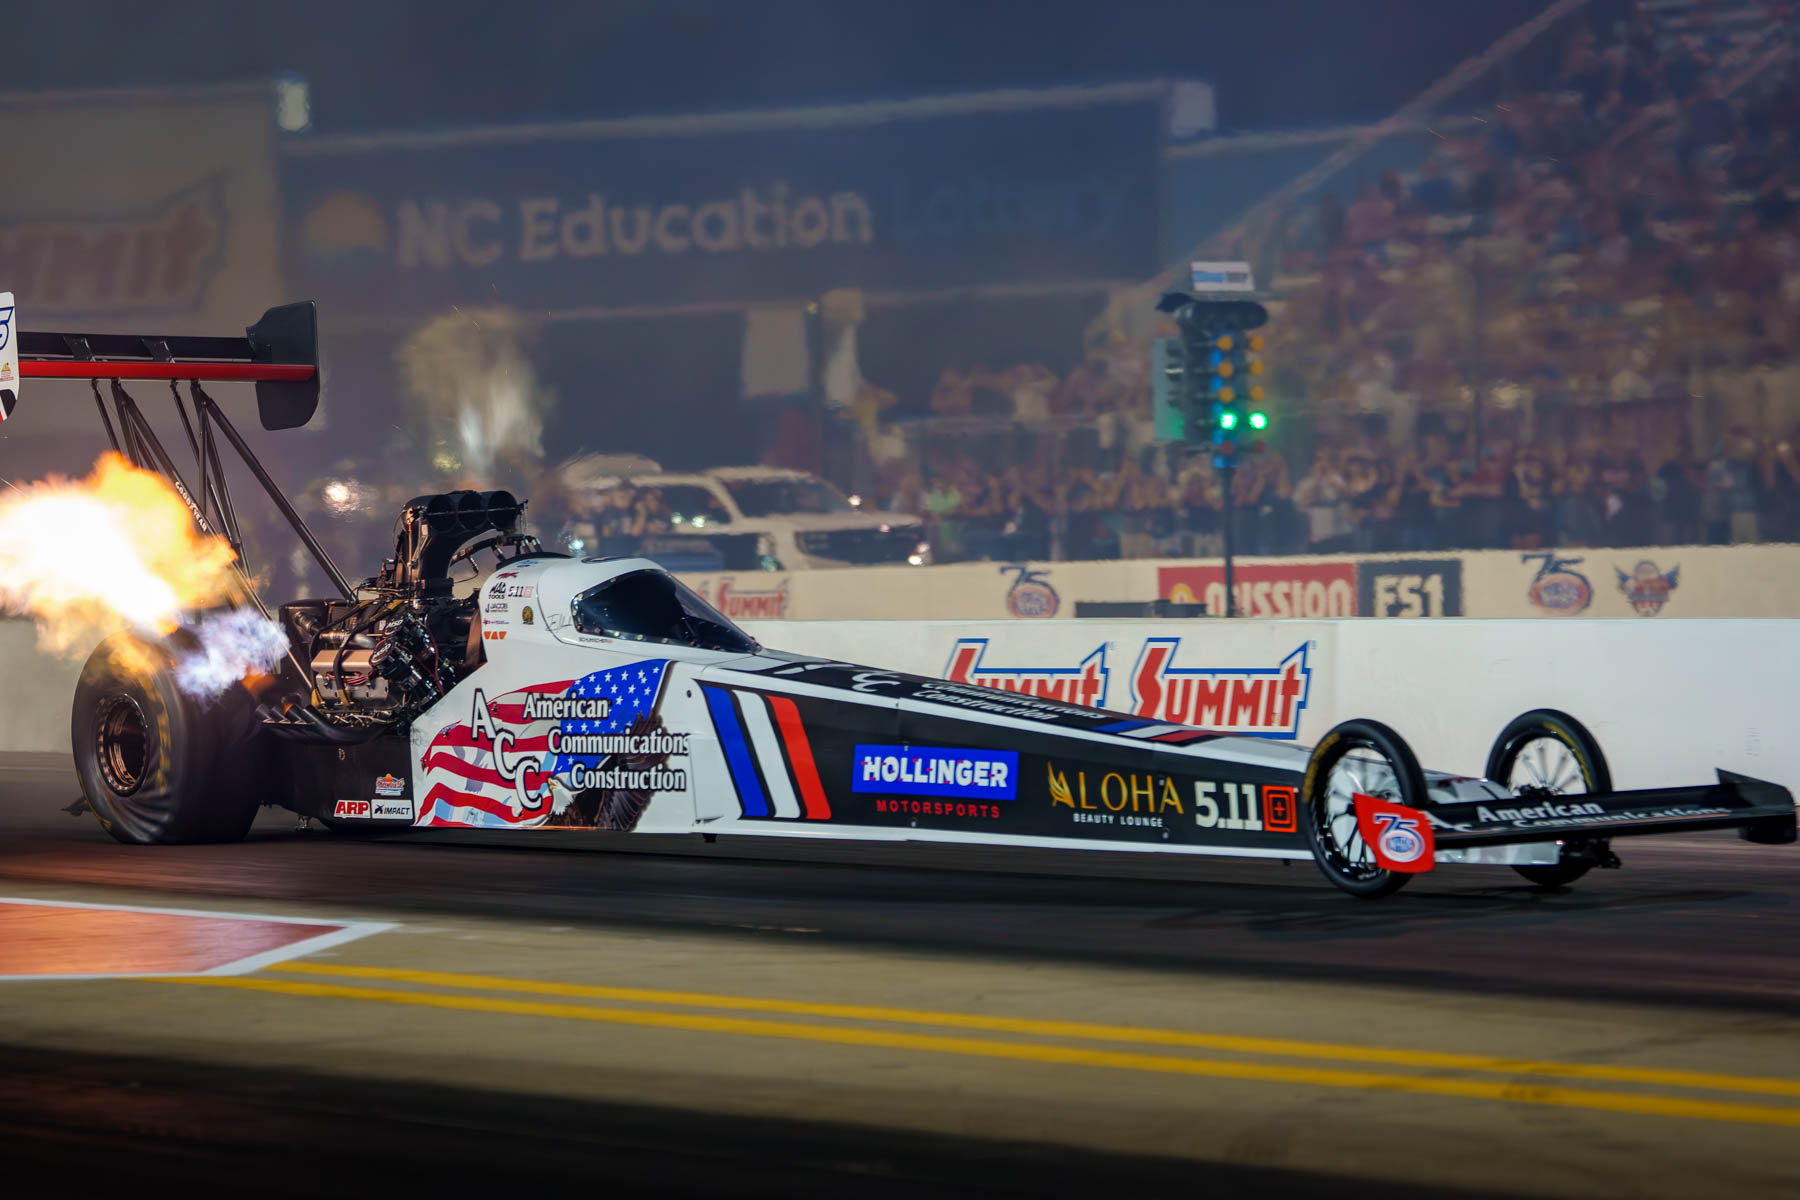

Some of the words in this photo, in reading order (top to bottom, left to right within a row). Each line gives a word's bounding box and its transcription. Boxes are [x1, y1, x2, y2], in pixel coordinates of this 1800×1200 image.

[397, 200, 504, 267] NC
[519, 184, 875, 262] Education
[1373, 574, 1445, 617] FS1
[1132, 641, 1305, 731] SUMMIT
[523, 690, 609, 719] American
[547, 726, 689, 755] Communications
[570, 762, 687, 791] Construction
[862, 755, 1009, 788] HOLLINGER
[1047, 760, 1185, 815] ALOHA
[335, 801, 369, 815] ARP
[383, 807, 410, 815] IMPACT
[875, 799, 1001, 819] MOTORSPORTS
[1073, 812, 1115, 825] BEAUTY
[1119, 815, 1164, 828] LOUNGE
[1193, 780, 1263, 831] 5.11
[1476, 800, 1606, 823] American
[1373, 812, 1426, 862] 75
